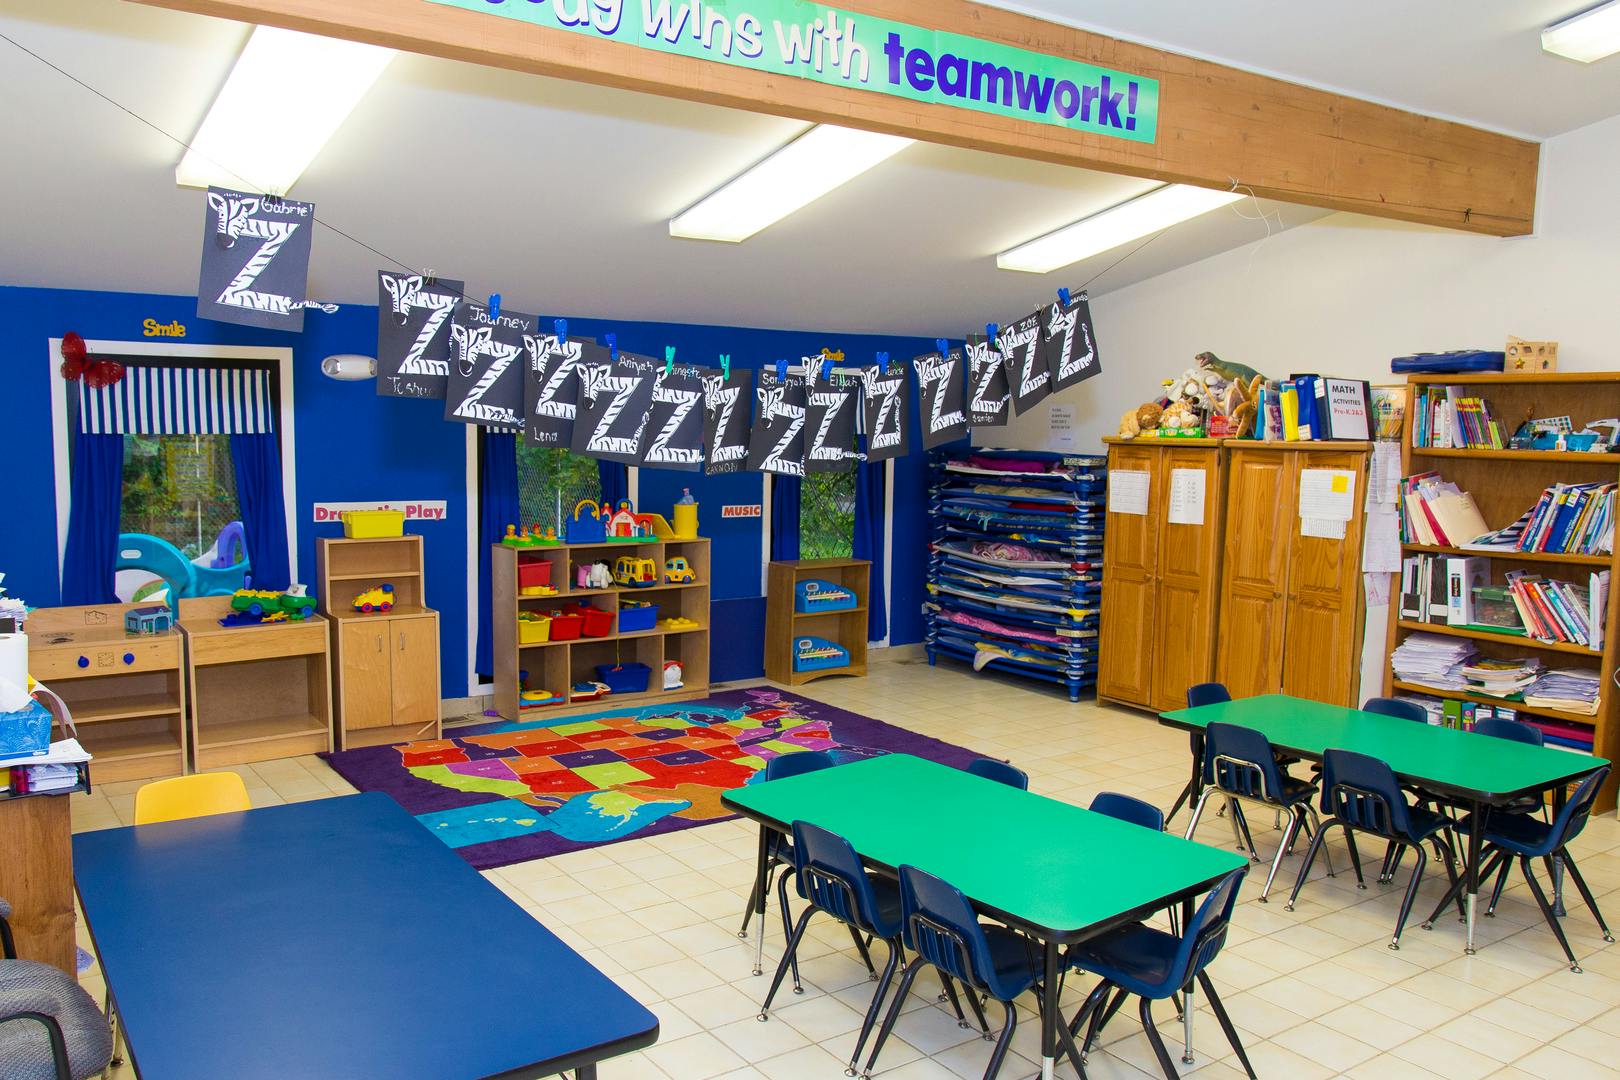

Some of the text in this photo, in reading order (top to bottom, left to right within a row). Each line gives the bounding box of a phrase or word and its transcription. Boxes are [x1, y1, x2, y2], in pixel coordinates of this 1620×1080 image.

[640, 0, 763, 58] wins
[773, 10, 870, 83] with
[884, 33, 1138, 131] teamwork!
[143, 318, 186, 337] Smile
[1332, 385, 1355, 394] MATH
[406, 505, 443, 520] Play
[724, 506, 760, 516] MUSIC
